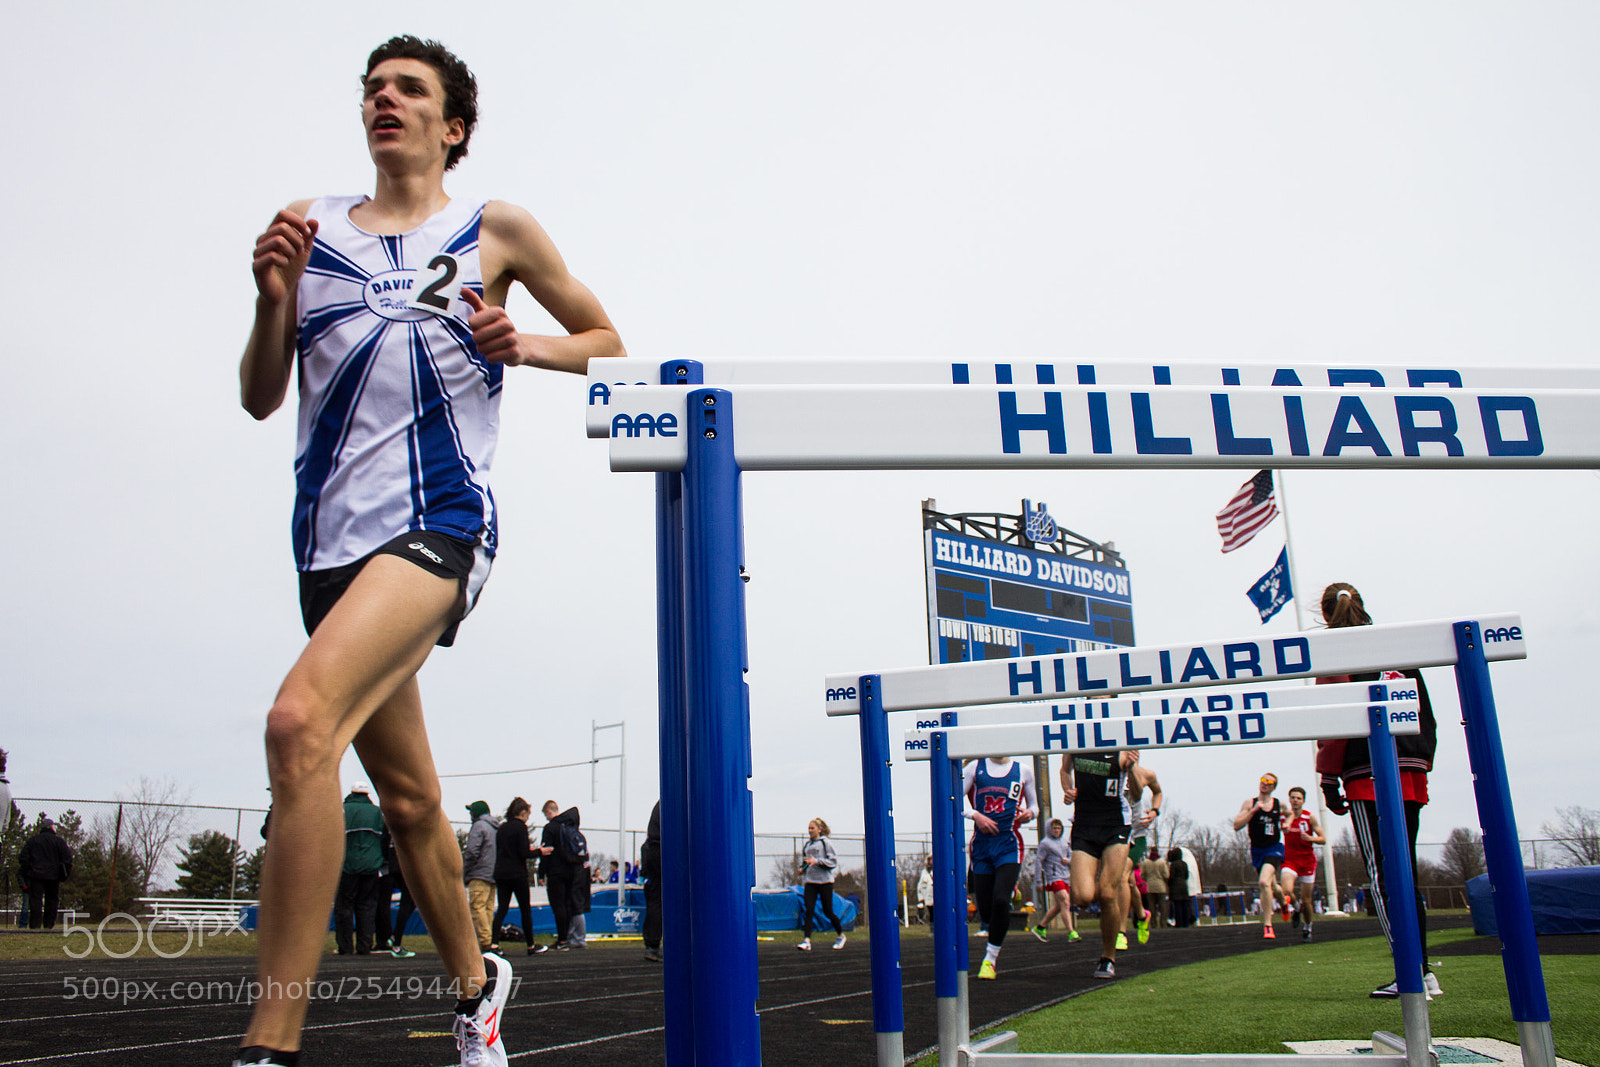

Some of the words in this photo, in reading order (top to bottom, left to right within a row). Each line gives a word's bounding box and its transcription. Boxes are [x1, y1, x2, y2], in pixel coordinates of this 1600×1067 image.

[416, 254, 458, 311] 2
[998, 391, 1545, 456] HILLIARD
[935, 537, 1032, 577] HILLIARD
[1036, 558, 1130, 597] DAVIDSON
[940, 619, 968, 641] DOWN
[972, 623, 991, 644] YDS
[991, 627, 1004, 645] TO
[1004, 629, 1018, 647] GO
[1008, 637, 1312, 696] HILLIARD
[1042, 712, 1266, 750] HILLIARD
[1012, 783, 1021, 798] 9
[1107, 780, 1117, 796] 4
[984, 795, 1007, 813] M
